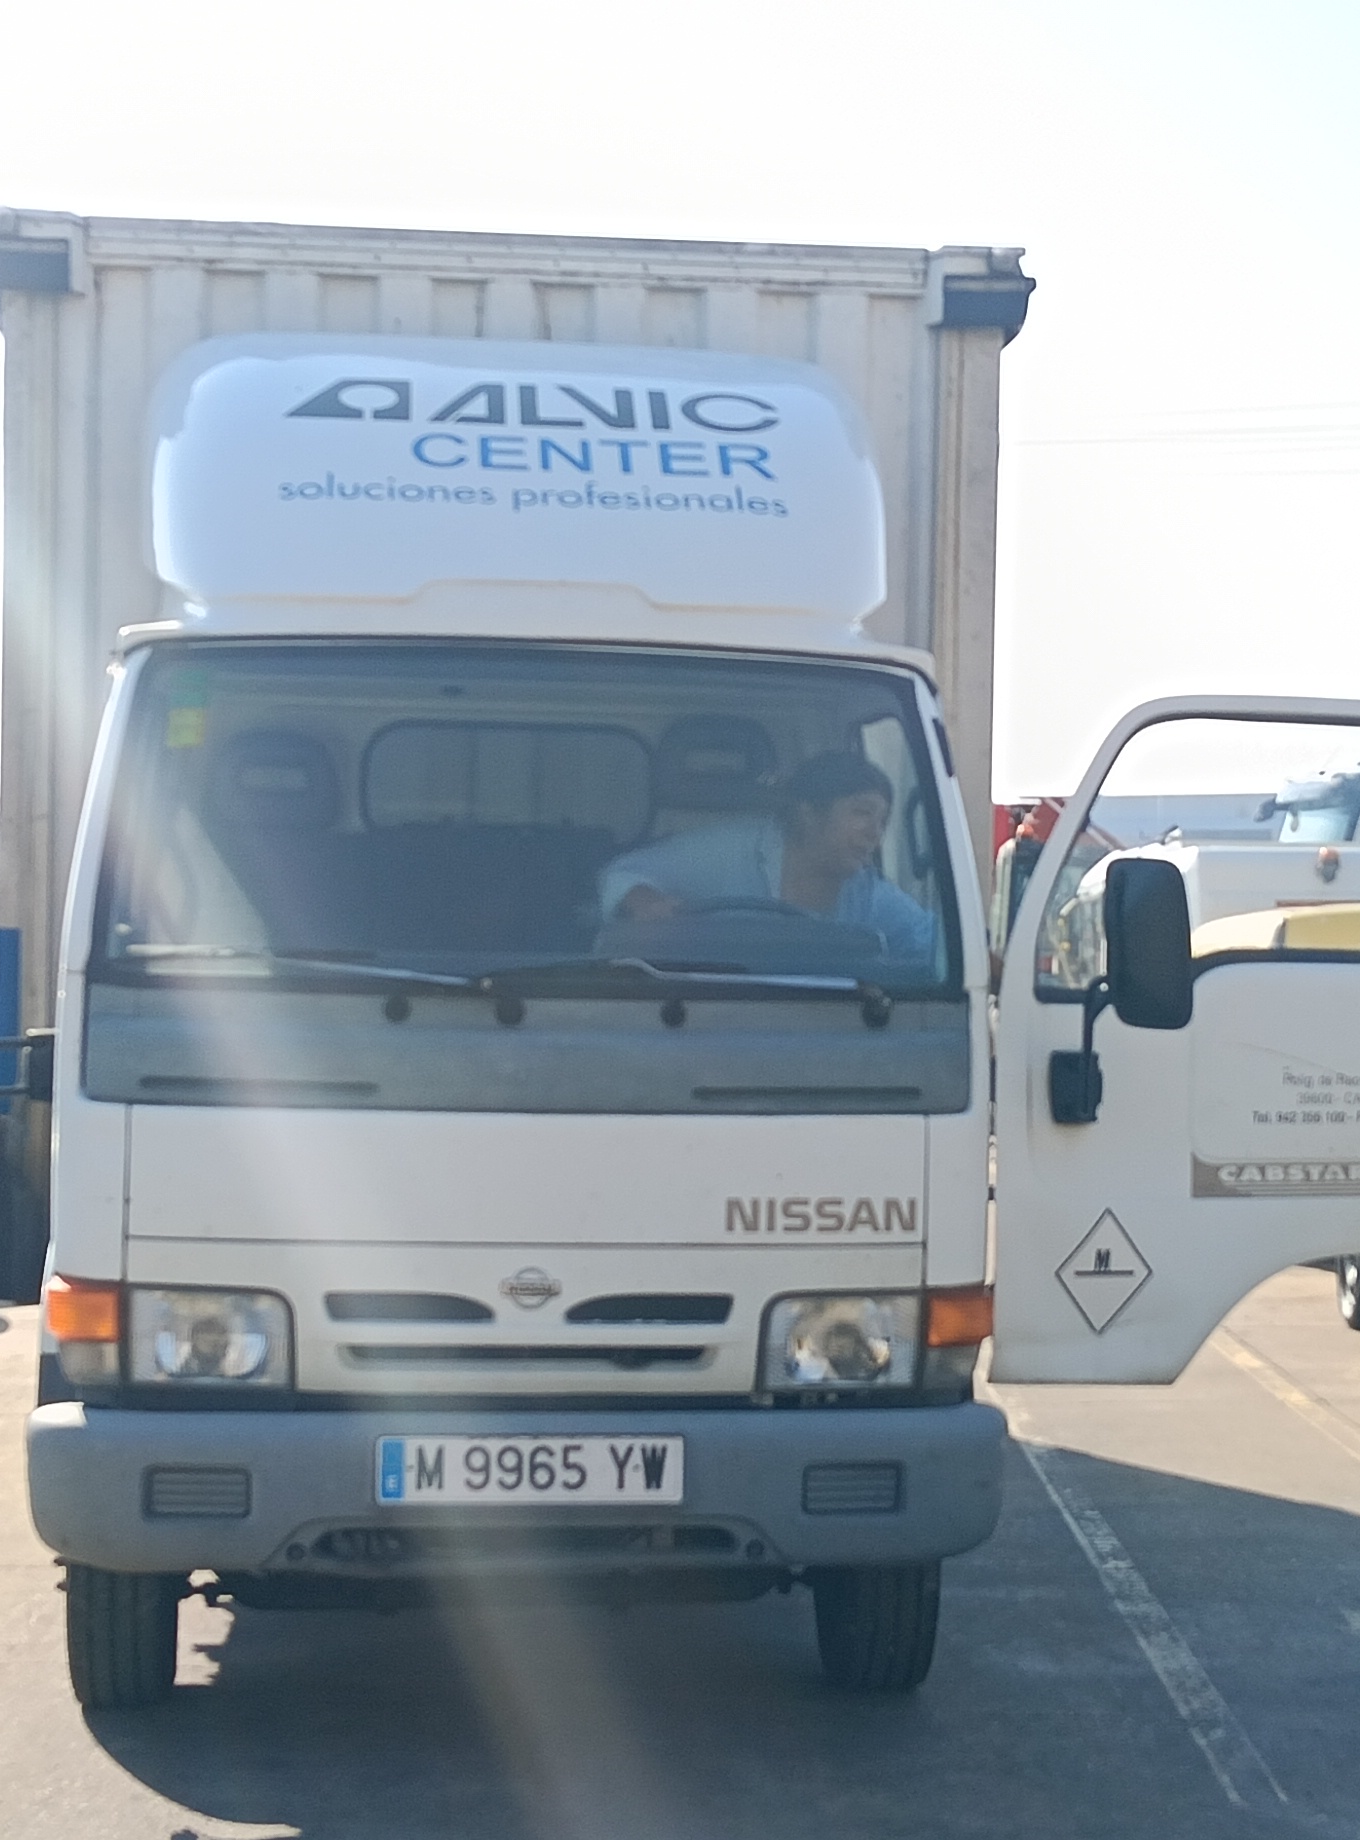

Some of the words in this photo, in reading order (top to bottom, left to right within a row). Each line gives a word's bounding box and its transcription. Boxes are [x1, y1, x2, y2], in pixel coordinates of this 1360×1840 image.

[427, 382, 781, 433] ALVIC
[412, 431, 779, 482] CENTER
[277, 470, 500, 505] soluciones
[511, 480, 790, 518] profesionales
[724, 1196, 919, 1233] NISSAN
[414, 1443, 446, 1491] M
[463, 1444, 588, 1491] 9965
[607, 1442, 669, 1491] YW
